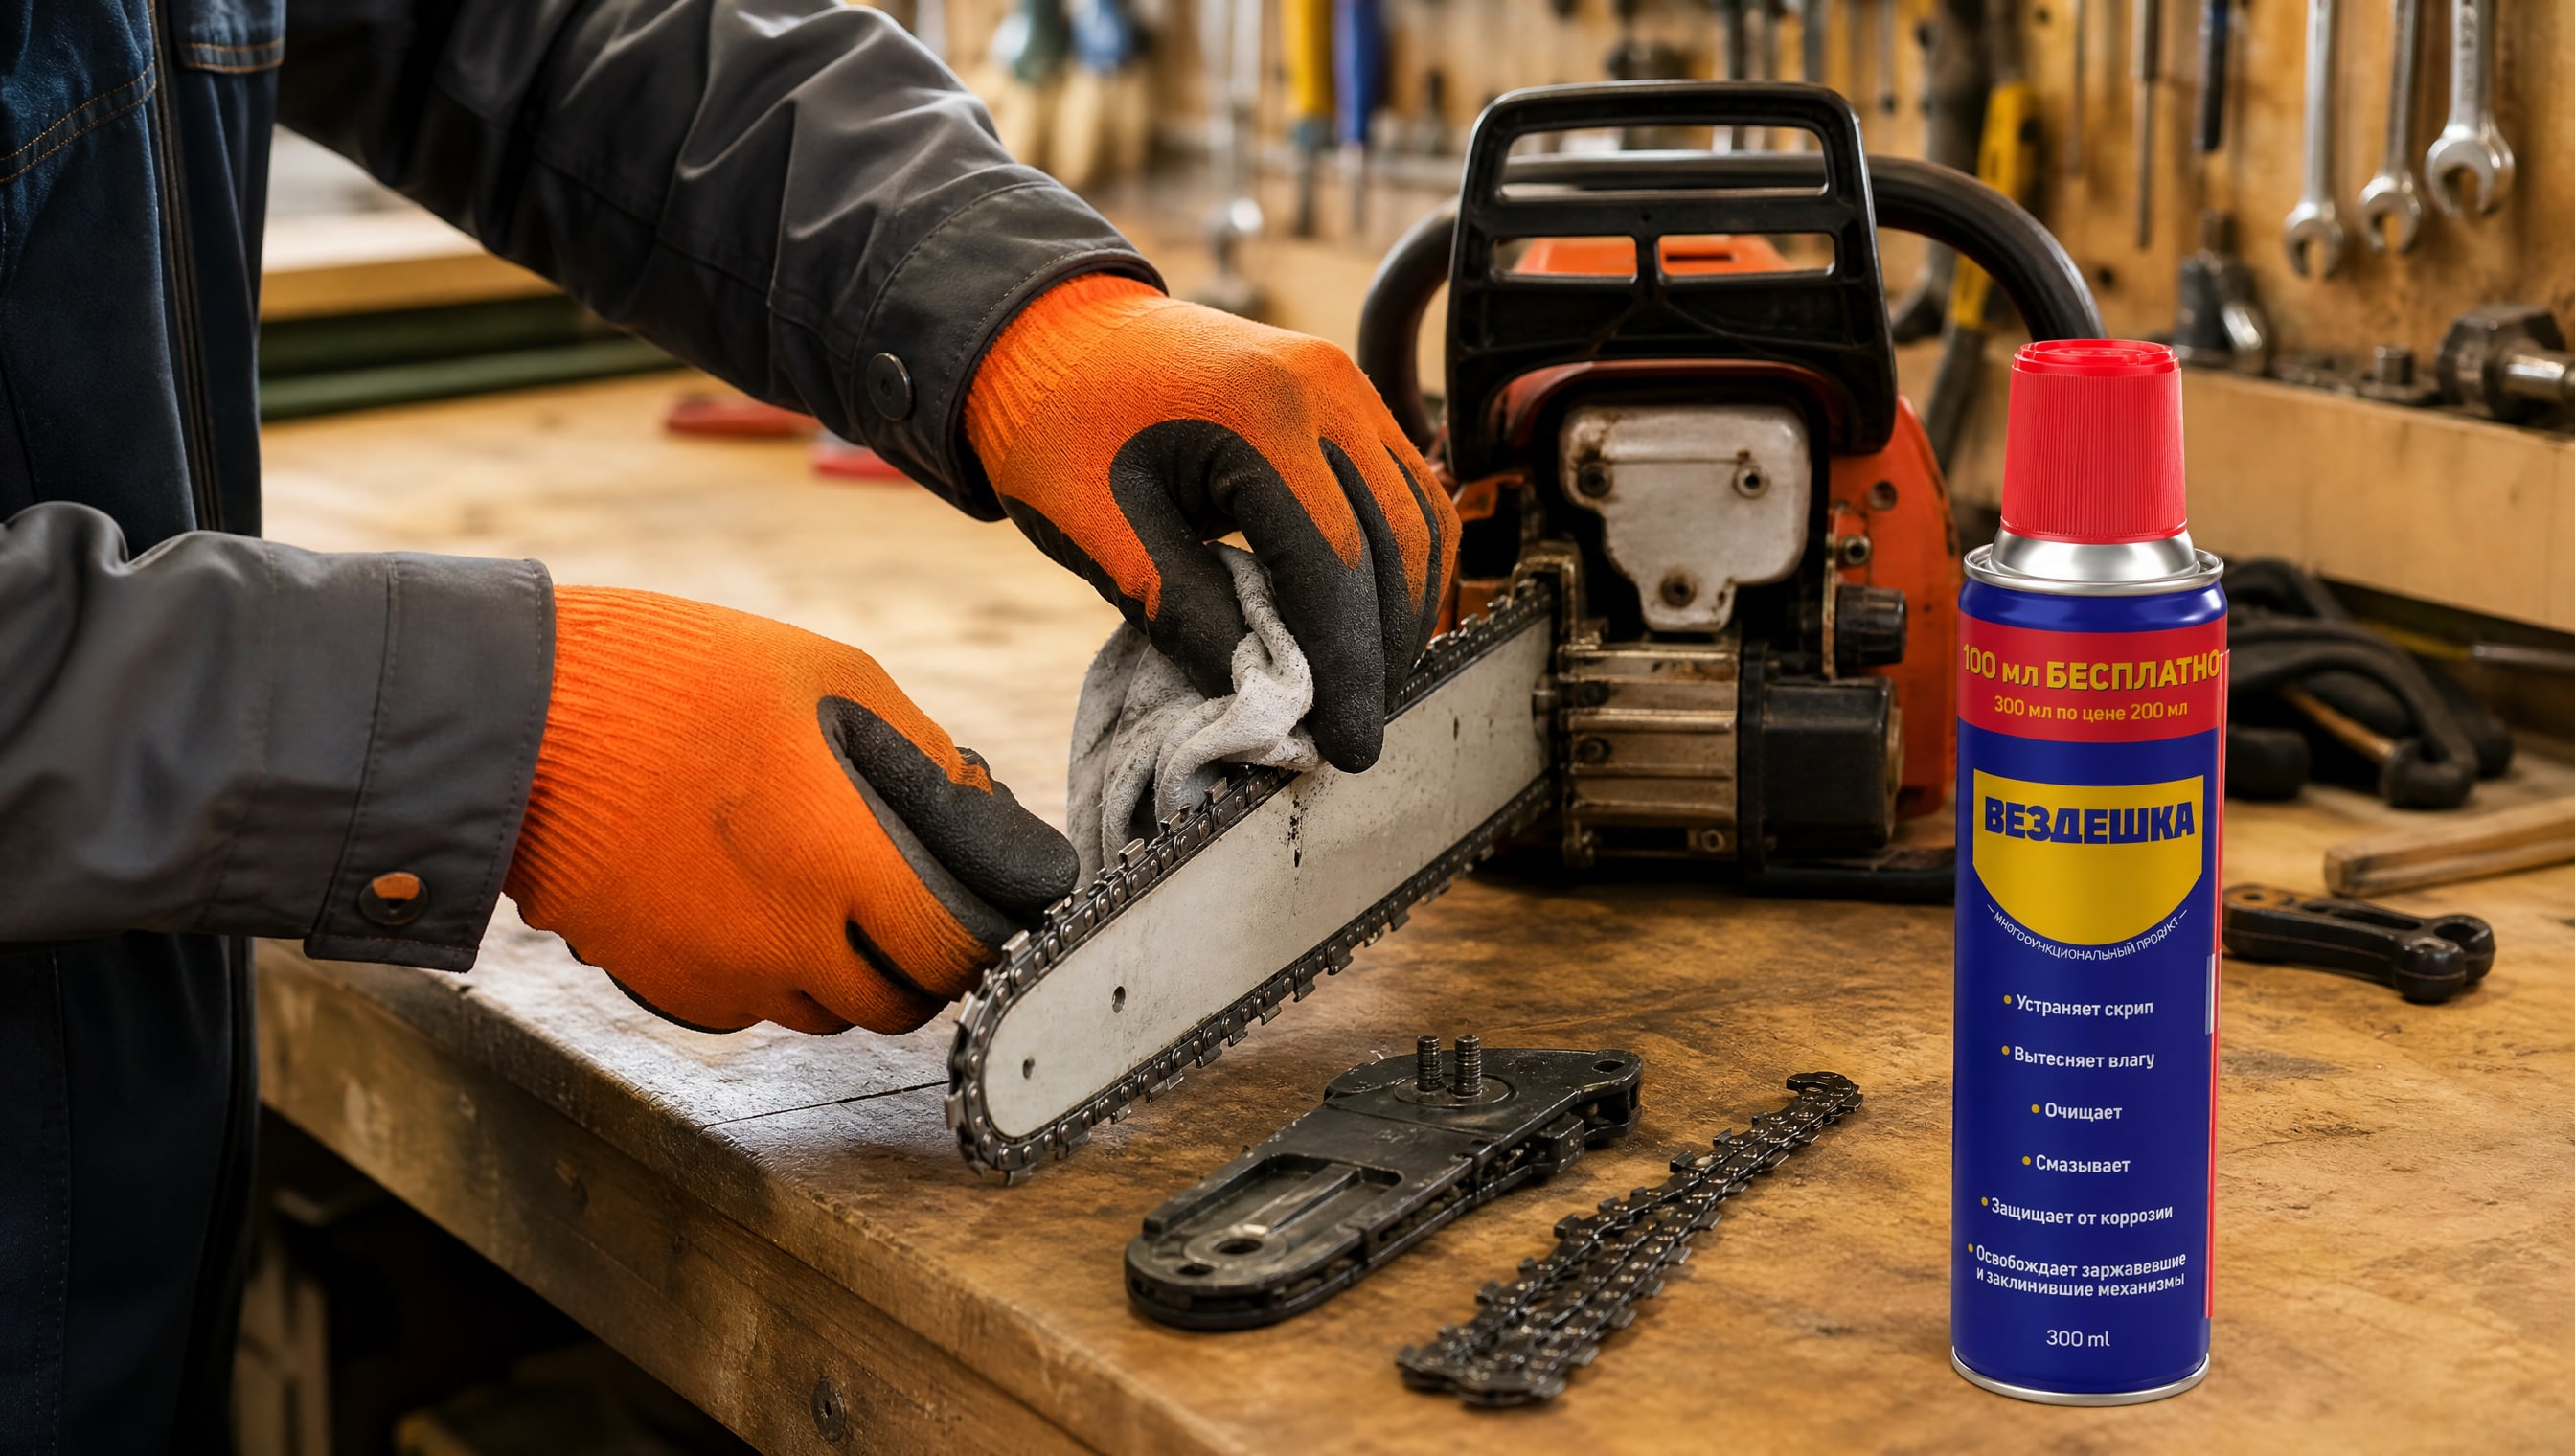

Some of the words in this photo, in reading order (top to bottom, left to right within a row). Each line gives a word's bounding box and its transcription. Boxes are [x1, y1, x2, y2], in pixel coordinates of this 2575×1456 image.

[1964, 644, 1995, 679] 100
[2002, 662, 2039, 687] мл
[1994, 695, 2024, 716] 300
[2029, 706, 2051, 719] мл
[2057, 707, 2077, 720] по
[2083, 708, 2126, 723] цене
[2131, 702, 2163, 720] 200
[2168, 702, 2188, 717] мл
[1985, 796, 2195, 845] ВЕЗДЕШКА
[2016, 994, 2101, 1017] Устраняет
[2105, 1002, 2153, 1019] скрип
[2014, 1046, 2105, 1068] Вытесняет
[2108, 1054, 2154, 1069] влагу
[2044, 1103, 2123, 1122] Очищает
[2036, 1154, 2131, 1173] Смазывает
[1992, 1197, 2074, 1224] Защищает
[2077, 1213, 2097, 1225] от
[2101, 1206, 2174, 1229] коррозии
[1976, 1245, 2078, 1278] Освобождает
[2082, 1253, 2186, 1281] заржавевшие
[1976, 1266, 1984, 1281] и
[1986, 1273, 2094, 1297] заклинившие
[2098, 1273, 2185, 1297] механизмы
[2046, 1329, 2084, 1348] 300
[2087, 1331, 2110, 1347] ml
